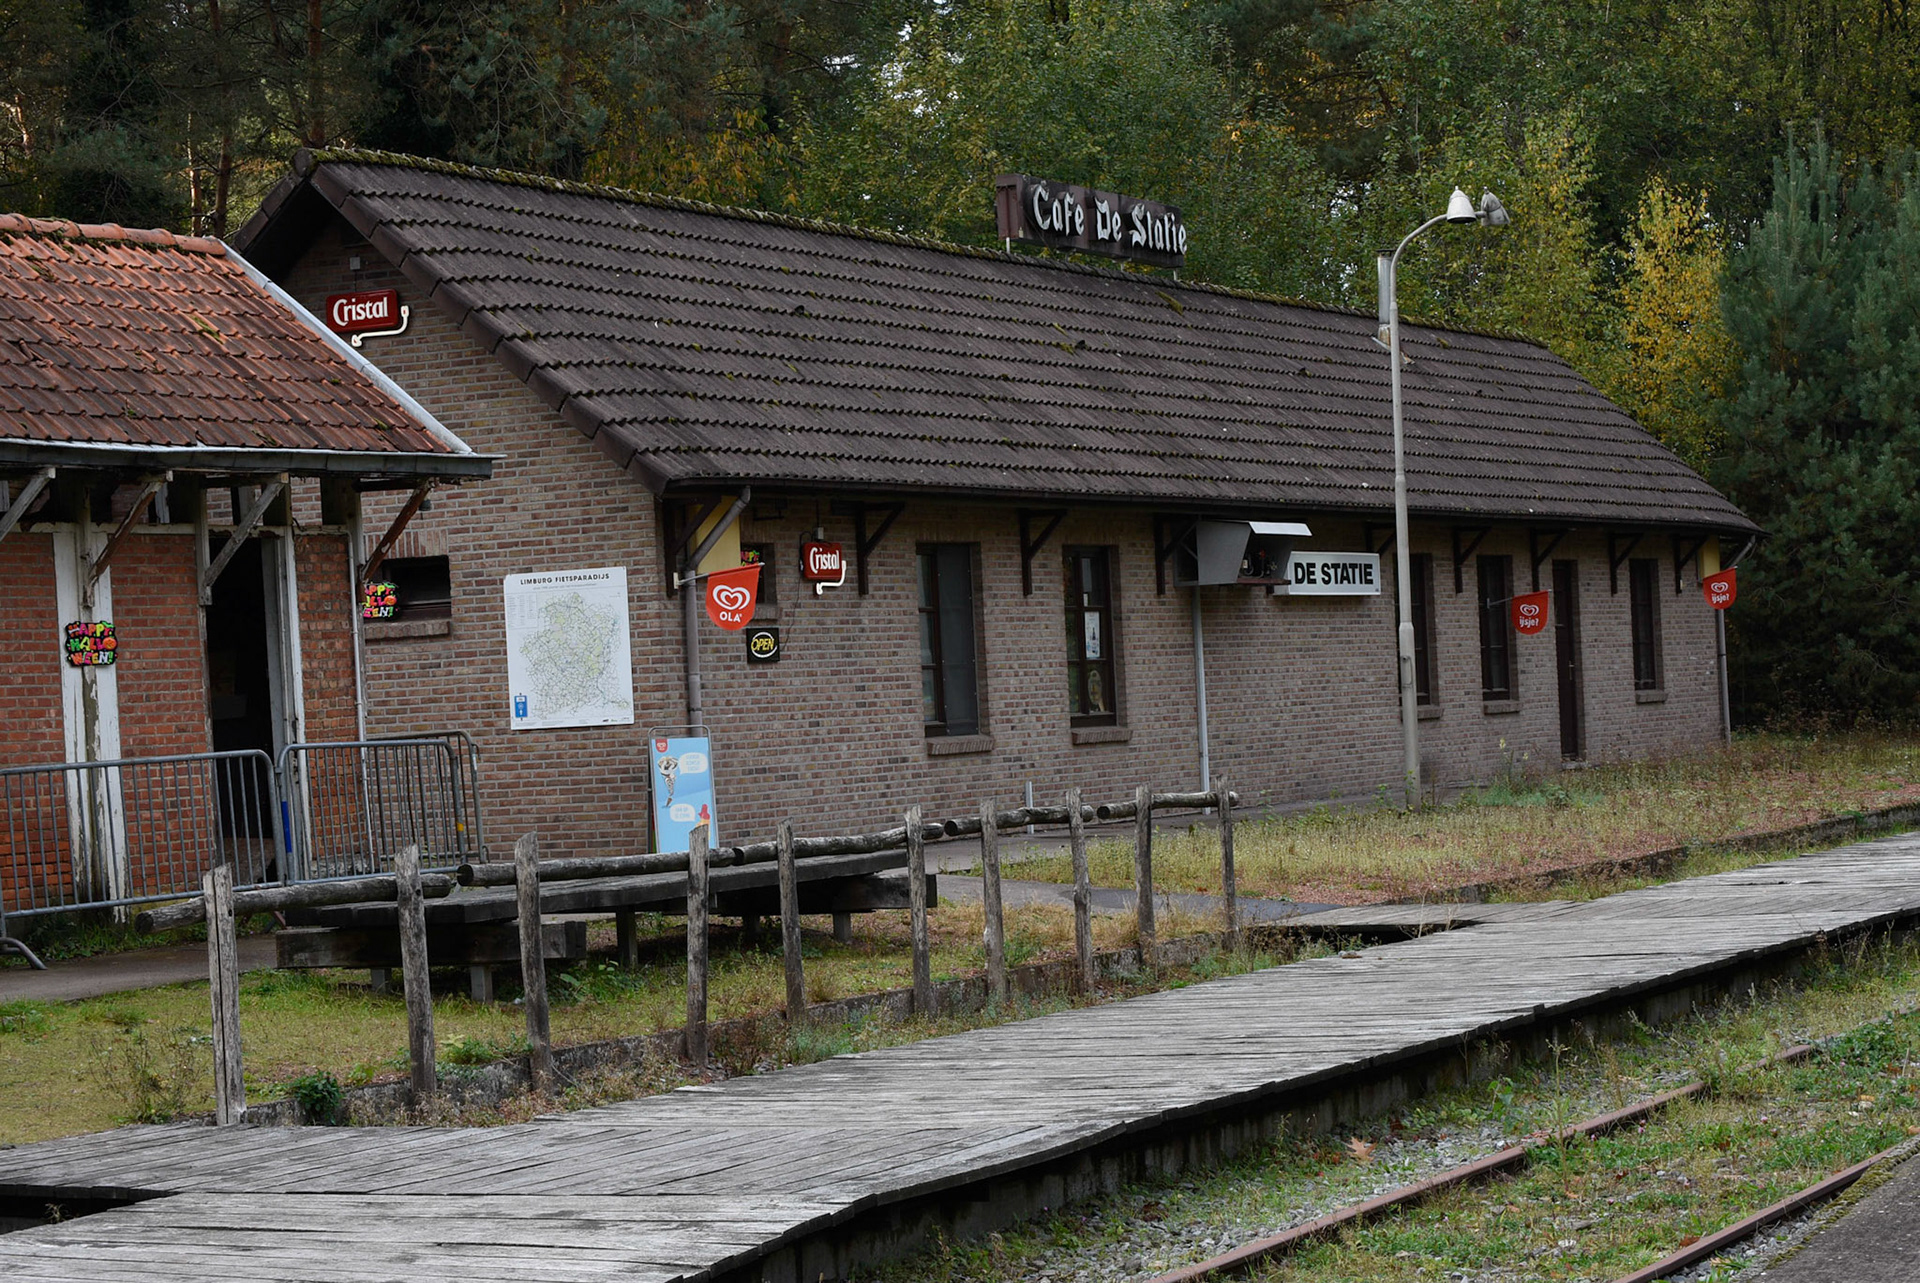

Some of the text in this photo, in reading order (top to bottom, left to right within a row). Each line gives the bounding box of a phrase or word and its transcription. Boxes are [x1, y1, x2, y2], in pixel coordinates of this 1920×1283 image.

[1095, 198, 1122, 241] De
[1129, 203, 1188, 256] Statie
[333, 296, 389, 327] Cristal
[809, 546, 840, 574] Cristal
[520, 572, 610, 585] LIMBURG FIETSPARADIJS
[1294, 562, 1374, 586] DE STATIE
[719, 611, 741, 623] OLA
[1519, 616, 1539, 628] ijsje?
[68, 622, 113, 637] HAPPY
[69, 636, 117, 651] HALLO
[751, 638, 775, 651] OPEN
